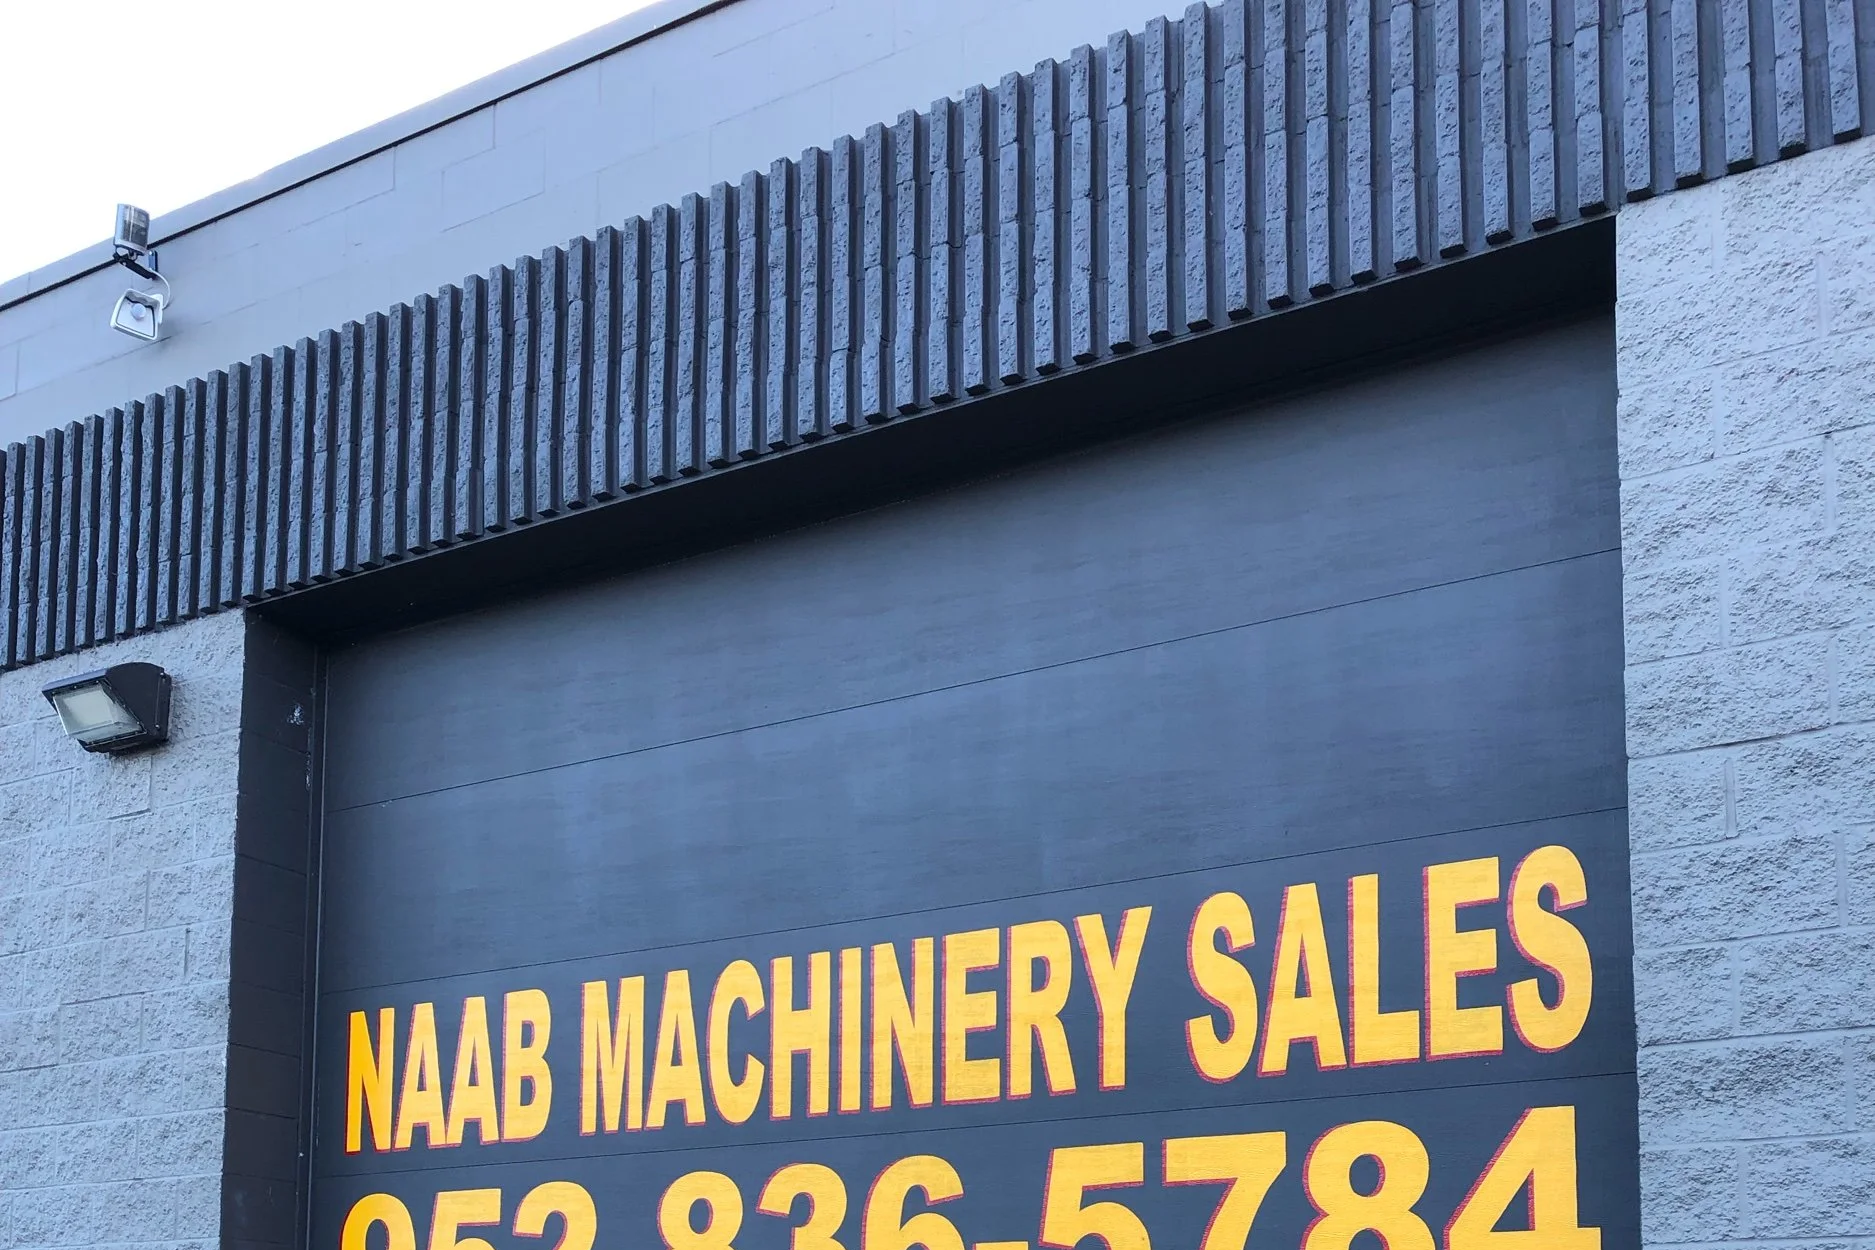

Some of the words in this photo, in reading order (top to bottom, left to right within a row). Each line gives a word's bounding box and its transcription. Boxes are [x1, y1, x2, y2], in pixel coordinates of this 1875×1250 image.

[344, 989, 552, 1154] NAAB
[580, 906, 1152, 1135] MACHINERY
[1185, 845, 1594, 1084] SALES
